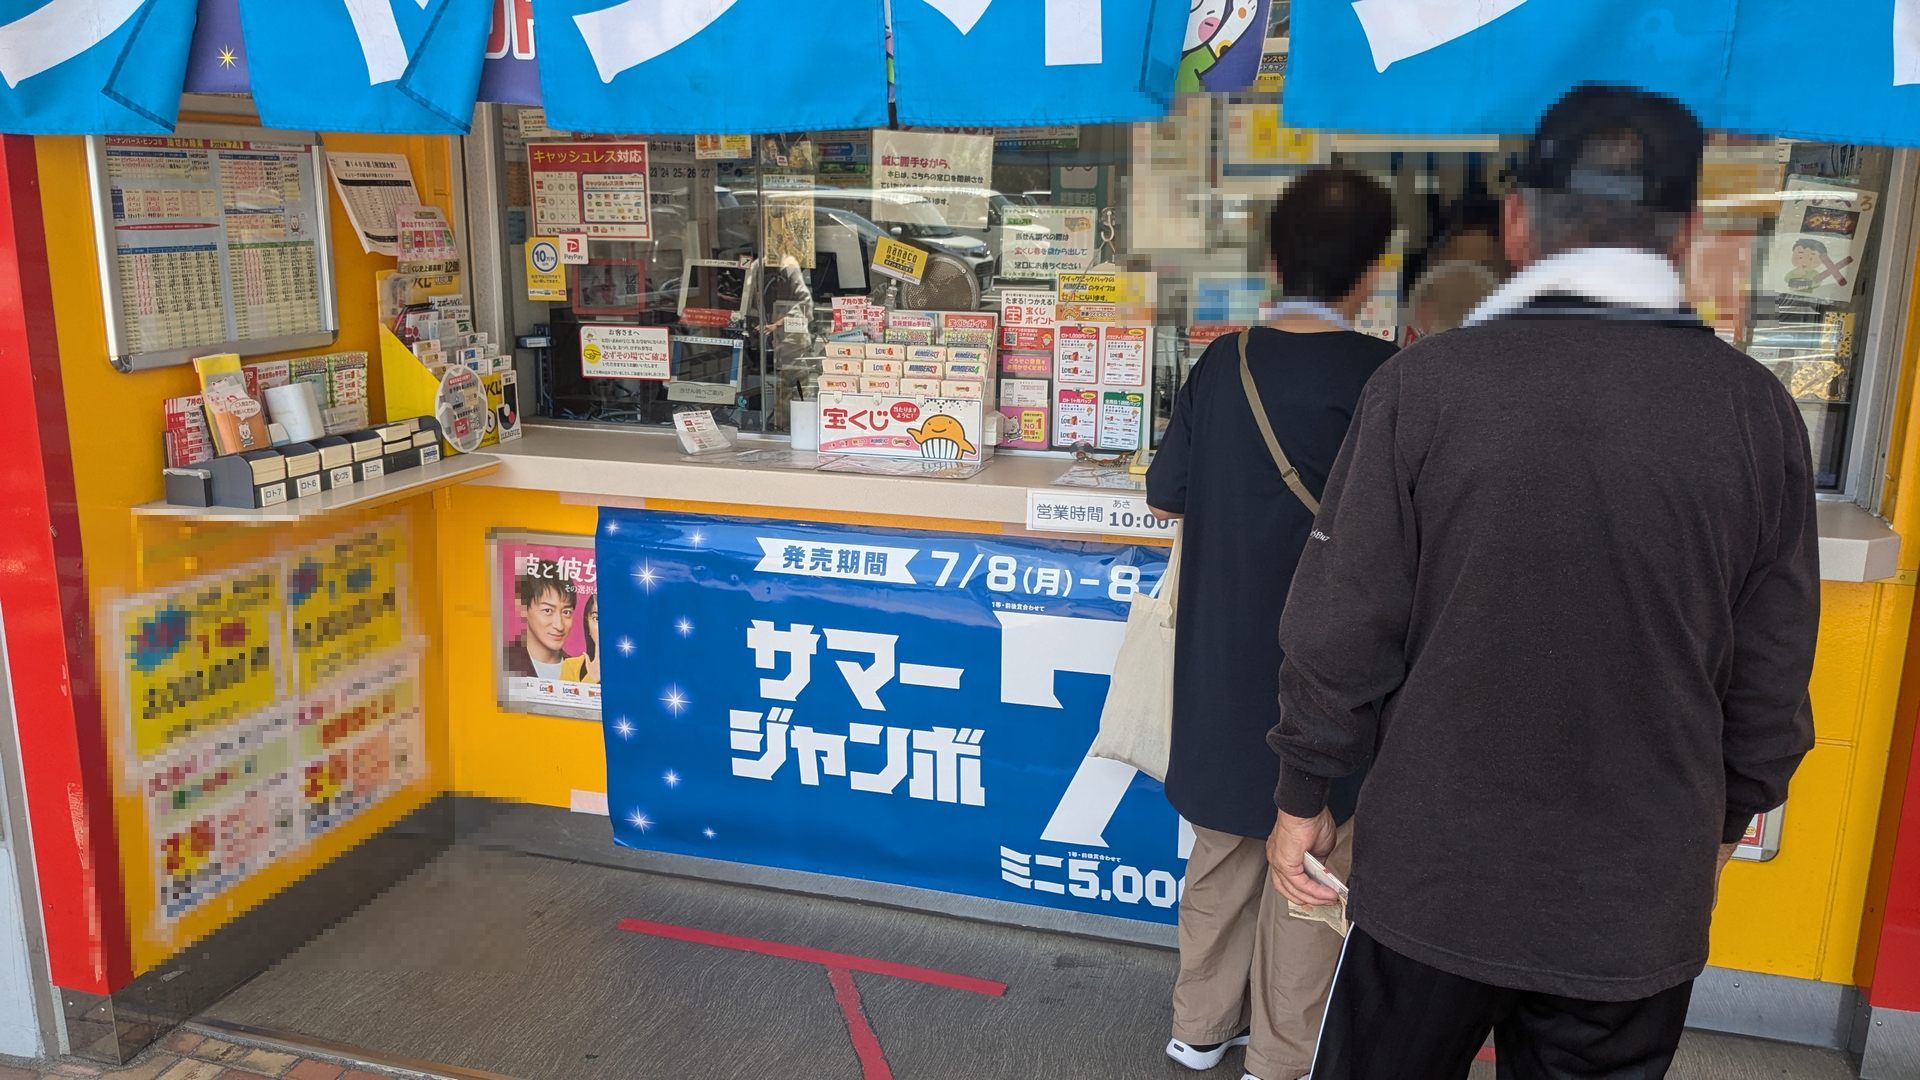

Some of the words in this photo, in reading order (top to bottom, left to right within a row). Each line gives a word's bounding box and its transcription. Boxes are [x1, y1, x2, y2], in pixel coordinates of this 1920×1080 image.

[533, 150, 642, 163] キャッシュレス対応
[880, 155, 951, 170] 誠に勝手ながら、
[661, 168, 669, 178] 24
[673, 169, 683, 178] 25
[687, 168, 697, 178] 26
[701, 169, 711, 178] 27
[886, 245, 918, 263] nanaco
[1014, 247, 1088, 256] 宝くじ券を袋から出して
[1014, 261, 1081, 270] 窓口にお持ちください
[1027, 298, 1056, 306] つかえる!
[1025, 306, 1047, 316] 宝くじ
[948, 318, 988, 329] 宝くじガイド
[1025, 316, 1055, 326] ポイント
[608, 328, 641, 337] お客さまへ
[602, 351, 667, 362] 必ずその場でご確認
[823, 408, 890, 432] 宝くじ
[300, 479, 317, 490] ロト6
[265, 488, 282, 498] ロト7
[1112, 500, 1131, 509] あさ
[1036, 504, 1104, 522] 営業時間
[782, 545, 889, 577] 発売期間
[992, 601, 1045, 611] 1等・前後賞合わせて
[746, 619, 965, 711] サマー
[729, 706, 986, 807] ジャンボ
